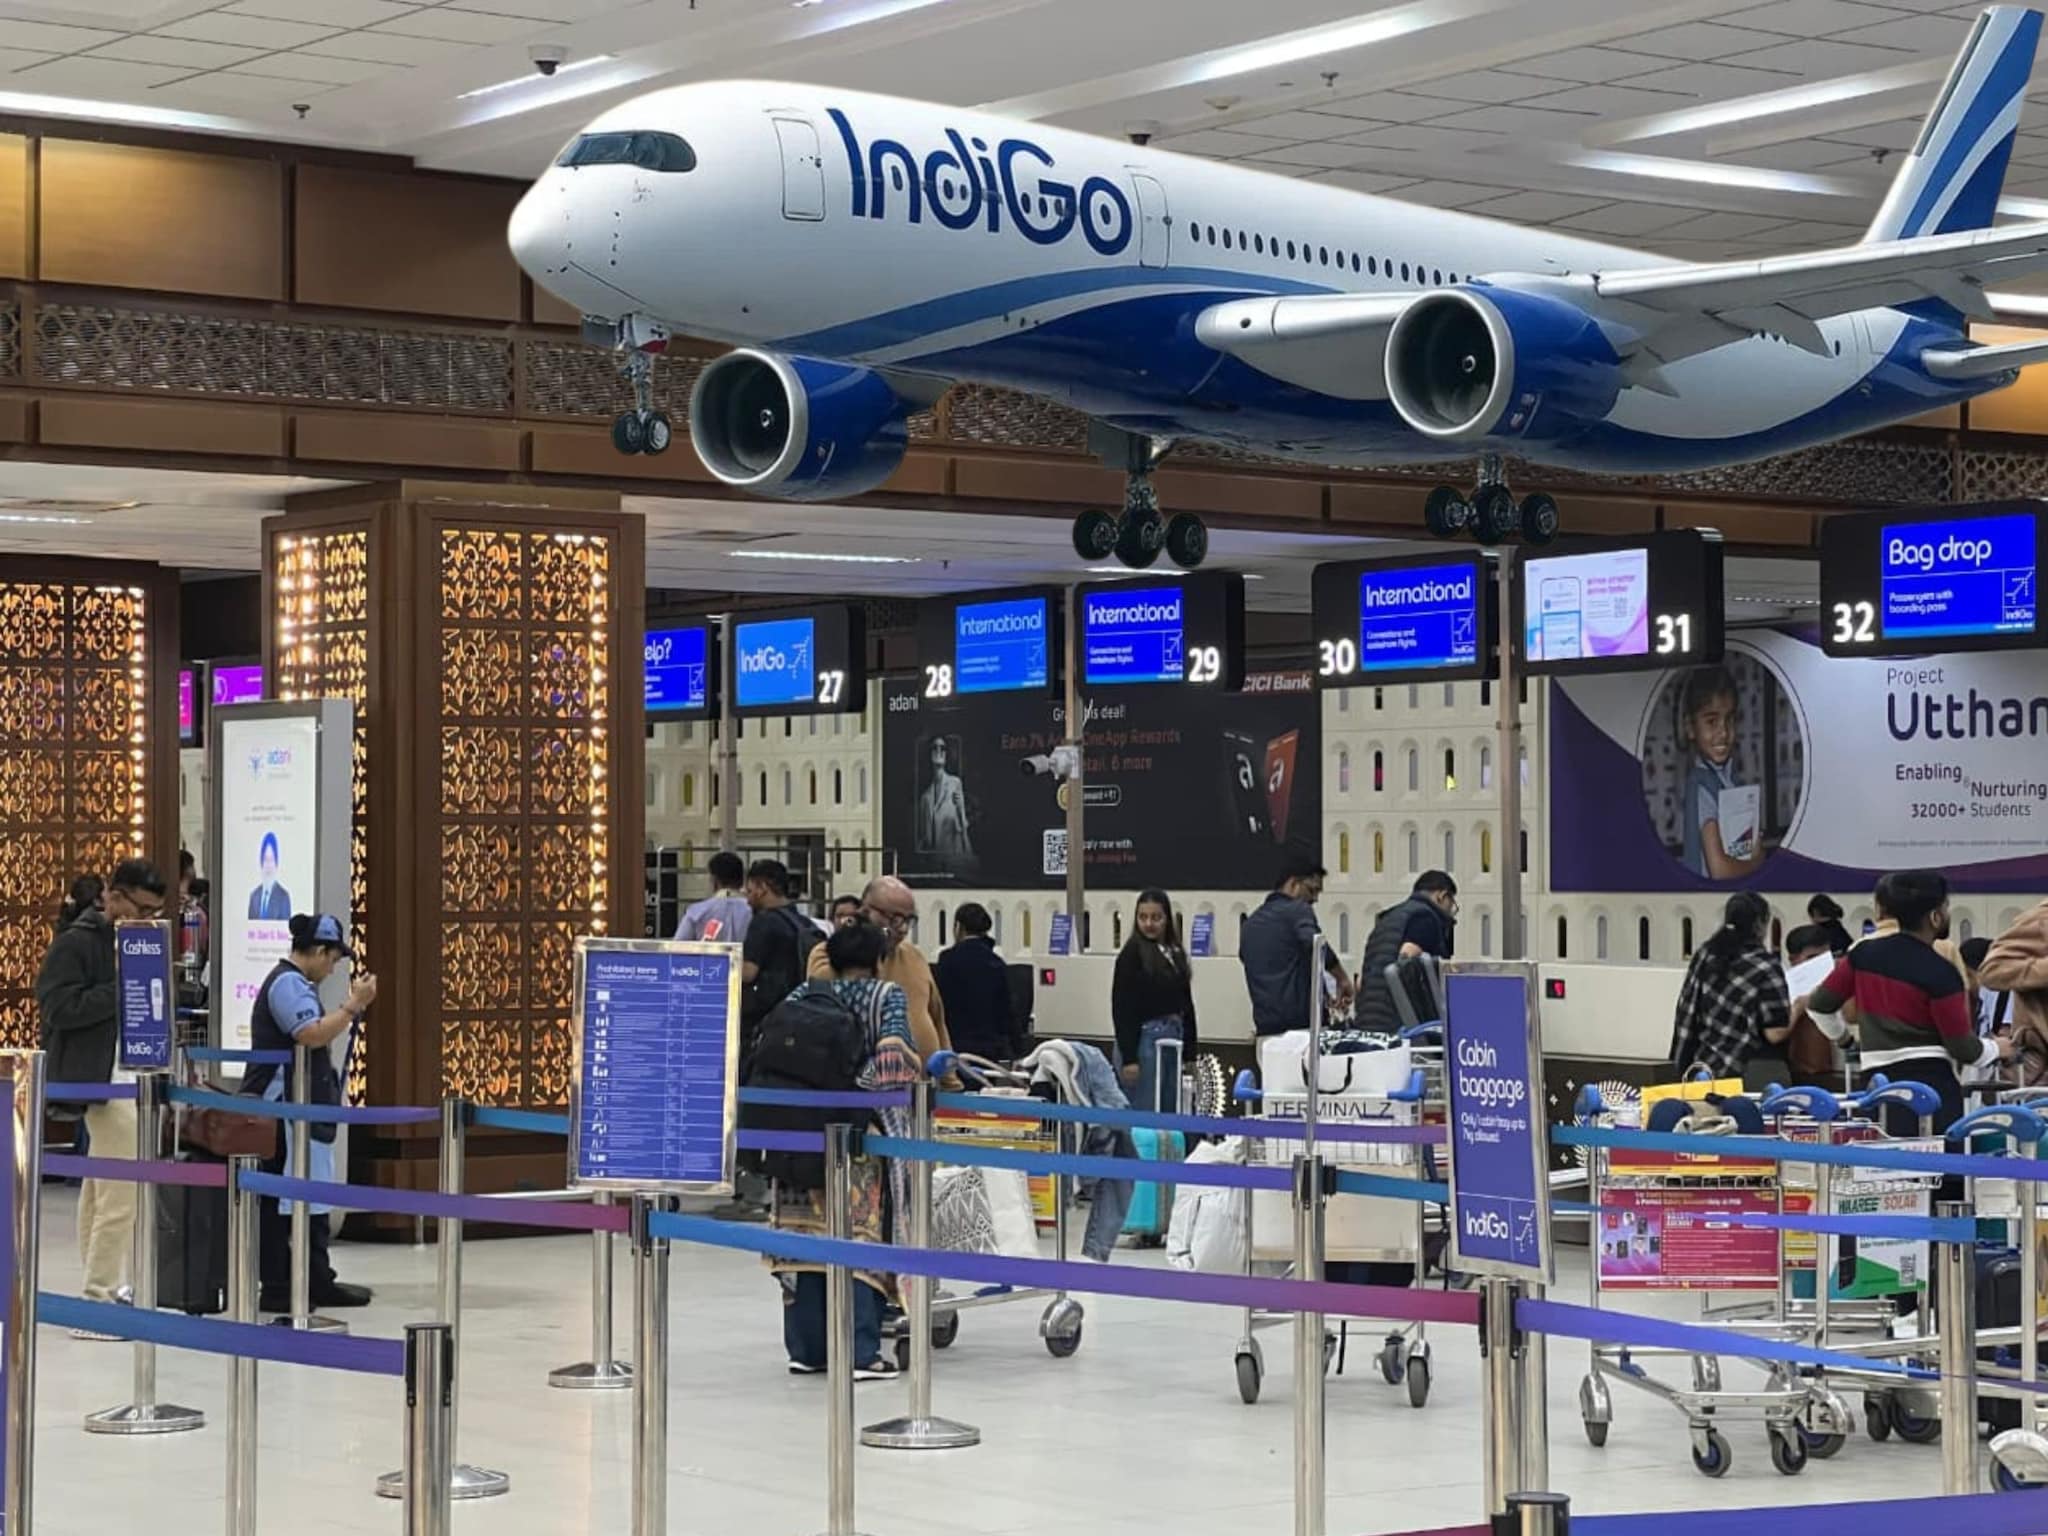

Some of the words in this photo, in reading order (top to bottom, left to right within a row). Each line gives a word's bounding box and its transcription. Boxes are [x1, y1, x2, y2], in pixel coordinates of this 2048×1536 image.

[826, 108, 1132, 256] IndiGo
[1889, 538, 1934, 571] Bag
[1938, 535, 1992, 567] drop
[1366, 575, 1471, 607] International
[959, 608, 1042, 636] International
[1089, 599, 1180, 626] International
[1833, 601, 1875, 643] 32
[2005, 609, 2033, 620] IndiGo
[1656, 614, 1690, 653] 31
[644, 637, 672, 666] elp?
[741, 646, 785, 673] IndiGo
[1188, 646, 1220, 682] 29
[1319, 638, 1356, 676] 30
[818, 670, 844, 703] 27
[925, 664, 952, 698] 28
[1273, 674, 1312, 690] Bank
[1887, 667, 1944, 687] Project
[889, 693, 919, 711] adani
[1896, 763, 1962, 783] Enabling
[1971, 780, 2047, 800] Nurturing
[1911, 803, 1965, 818] 32000+
[1970, 802, 2032, 817] Students
[123, 938, 161, 955] Cashless
[127, 1040, 152, 1056] IndiGo
[1458, 1038, 1497, 1068] Cabin
[1460, 1073, 1525, 1108] baggage
[1884, 1193, 1918, 1210] SOLAR
[1466, 1209, 1508, 1239] IndiGo
